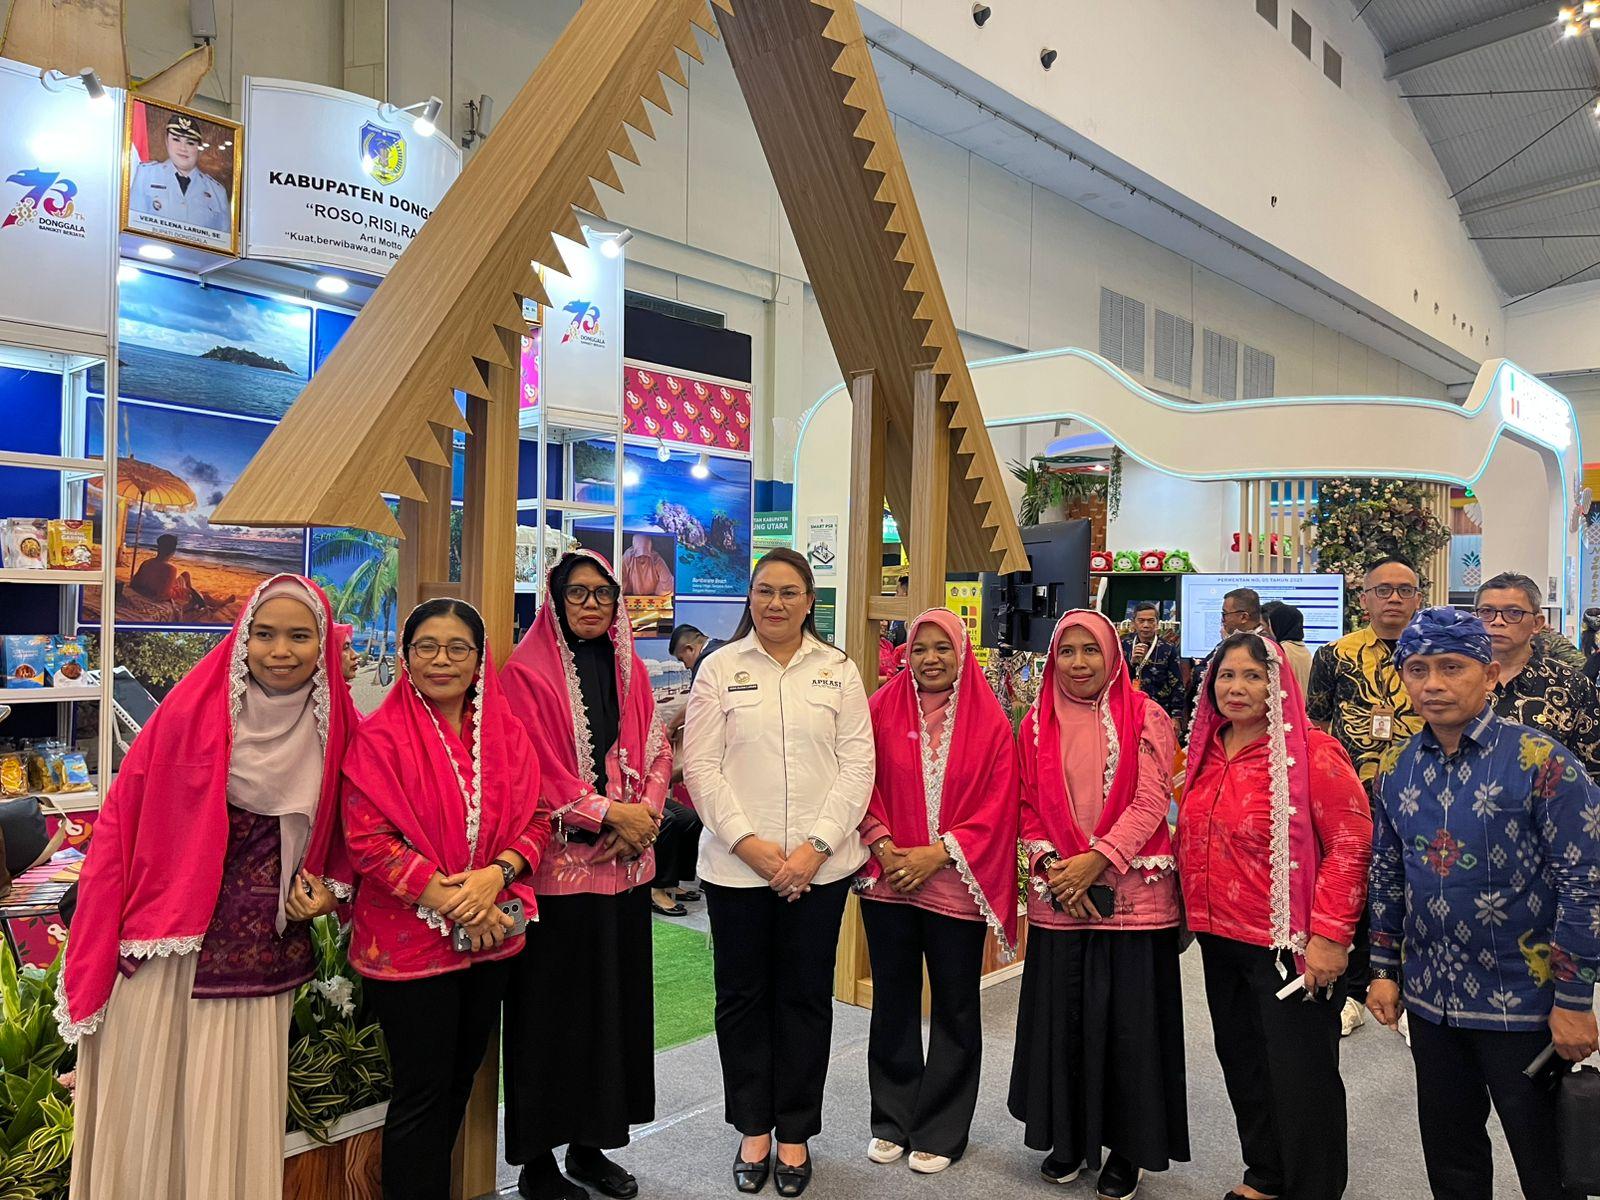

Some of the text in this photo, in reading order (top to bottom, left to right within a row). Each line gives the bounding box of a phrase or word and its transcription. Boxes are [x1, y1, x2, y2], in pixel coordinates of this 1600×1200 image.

[269, 171, 384, 205] KABUPATEN
[39, 217, 86, 233] DONGGALA
[140, 215, 159, 224] VERA
[159, 220, 182, 231] ELENA
[211, 231, 221, 239] SE
[359, 233, 403, 251] Arti Motto
[580, 334, 606, 345] DONGGALA
[766, 522, 788, 530] UTARA
[812, 679, 842, 688] APKASI
